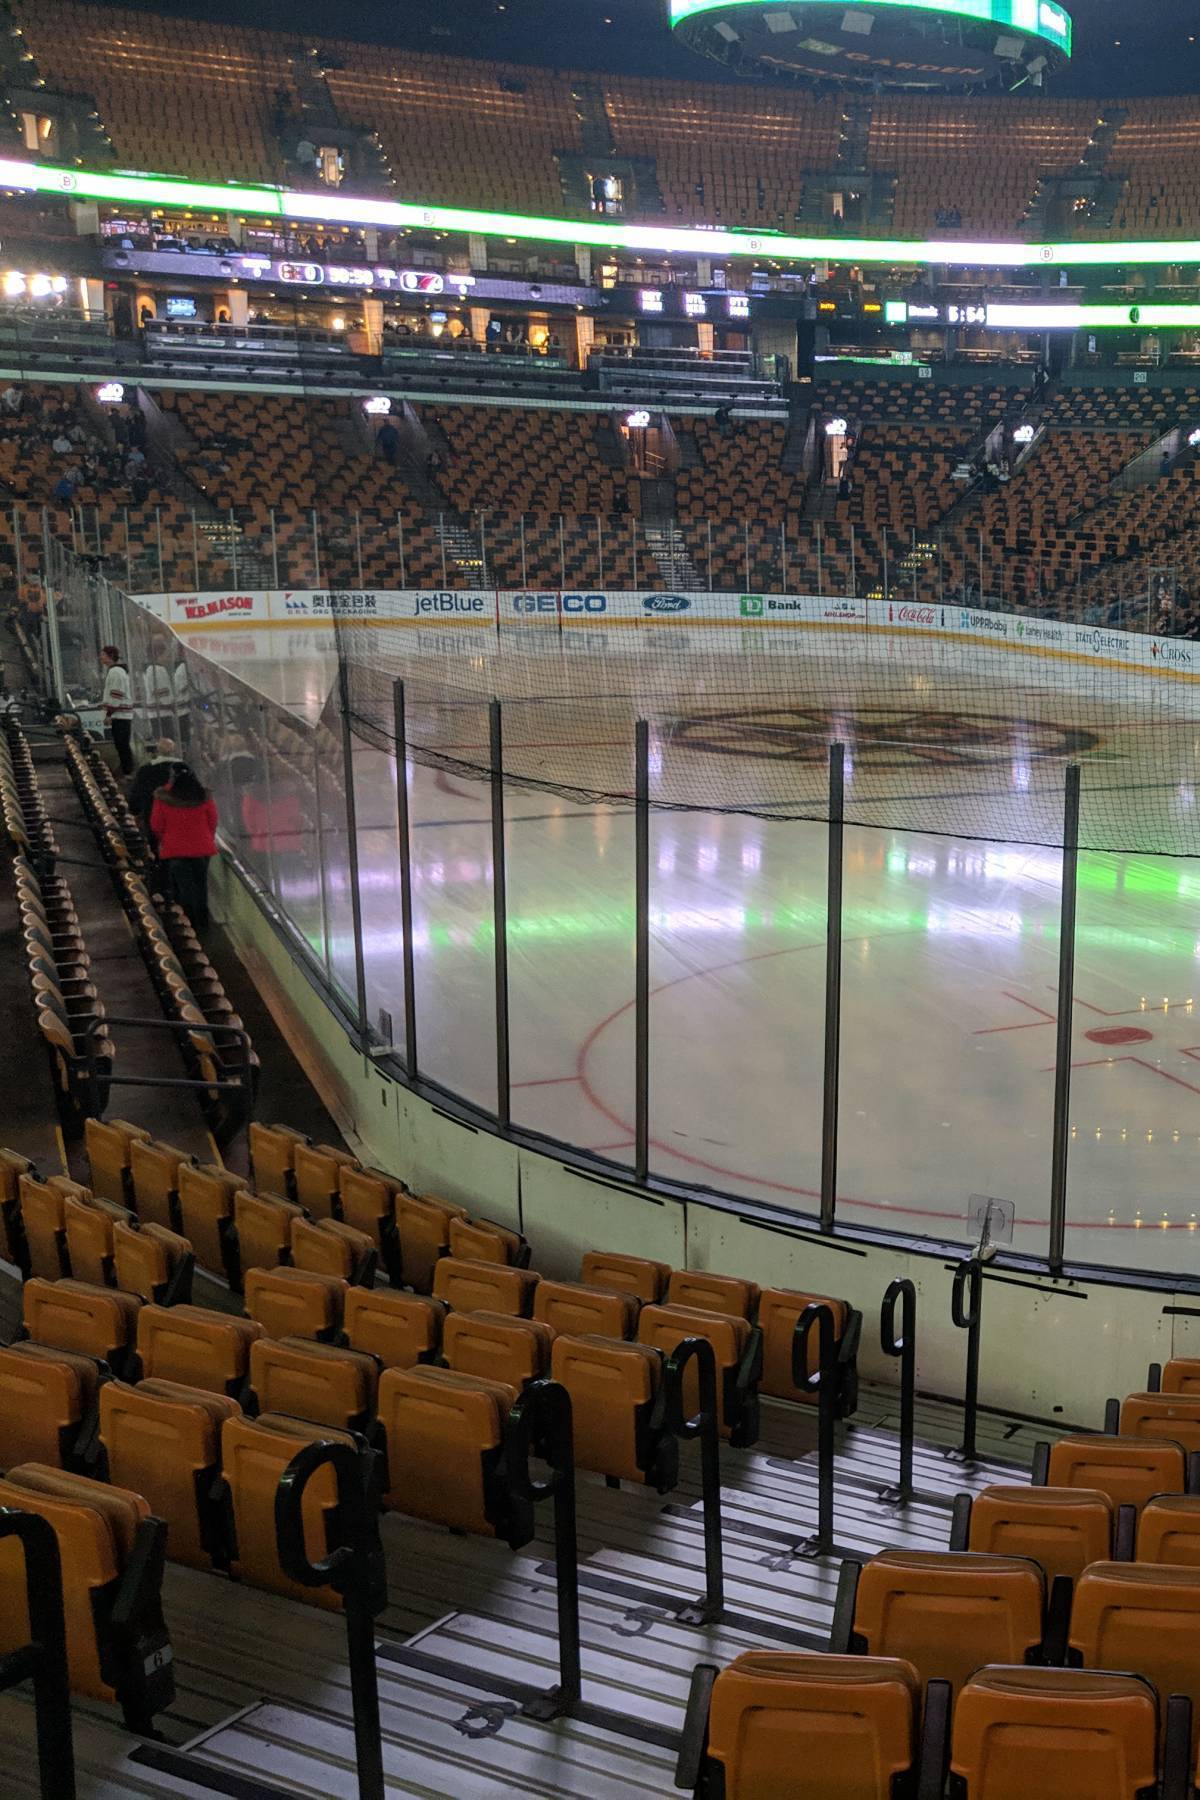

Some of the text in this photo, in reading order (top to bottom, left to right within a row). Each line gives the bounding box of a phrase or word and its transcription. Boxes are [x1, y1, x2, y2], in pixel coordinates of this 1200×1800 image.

[845, 52, 985, 75] GARDEN
[413, 592, 485, 616] jetBlue
[513, 595, 607, 613] GEICO
[650, 597, 683, 611] Ford
[768, 600, 801, 610] Bank
